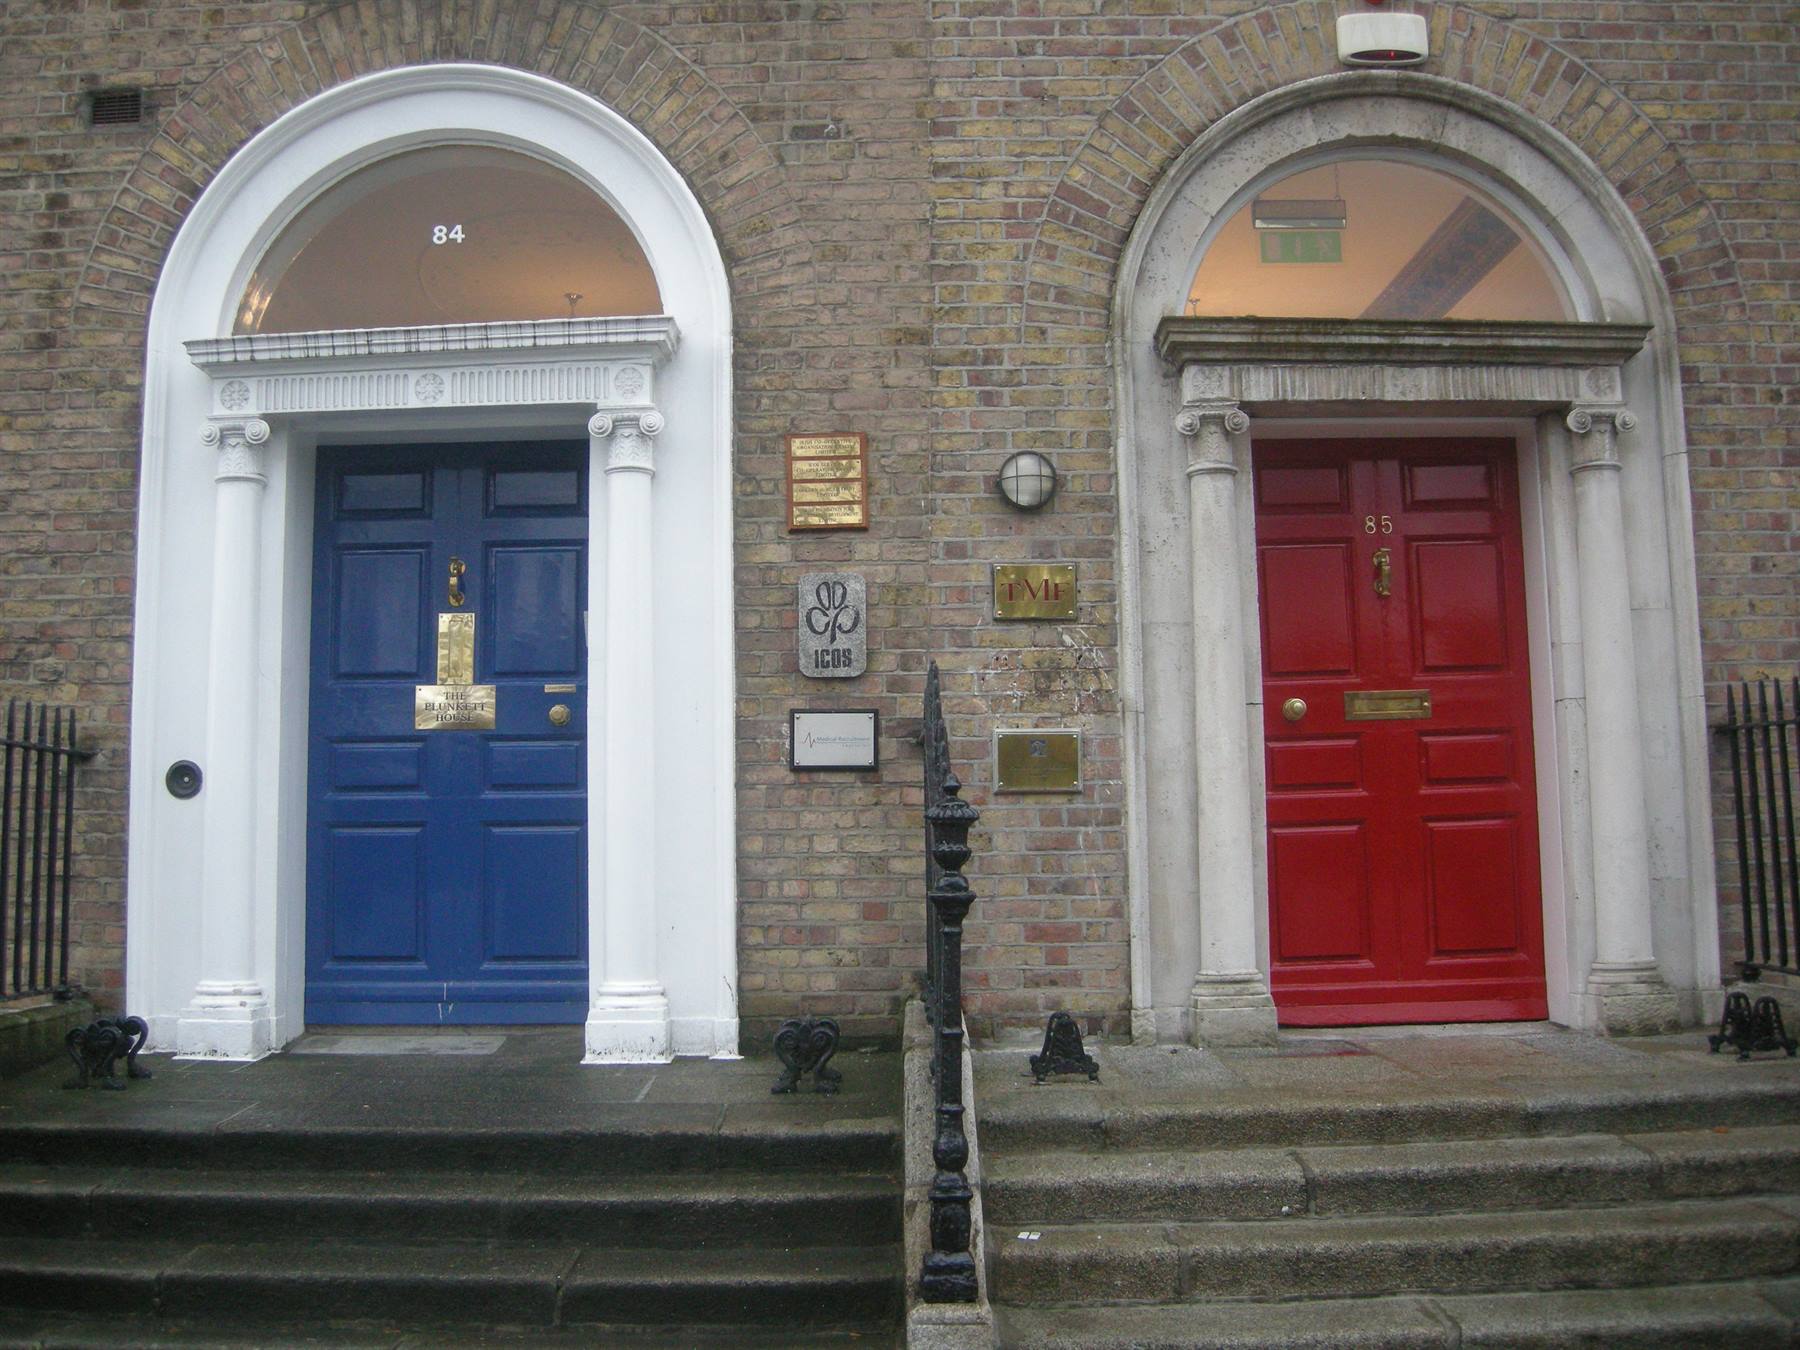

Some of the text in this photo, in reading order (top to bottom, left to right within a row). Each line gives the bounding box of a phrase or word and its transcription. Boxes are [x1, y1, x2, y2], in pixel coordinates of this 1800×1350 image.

[433, 224, 465, 244] 84
[1365, 515, 1393, 534] 85
[1000, 578, 1071, 602] TMF
[814, 648, 852, 669] ICOS
[443, 691, 467, 700] THE
[424, 702, 487, 711] PLUNKETT
[435, 713, 474, 722] HOUSE
